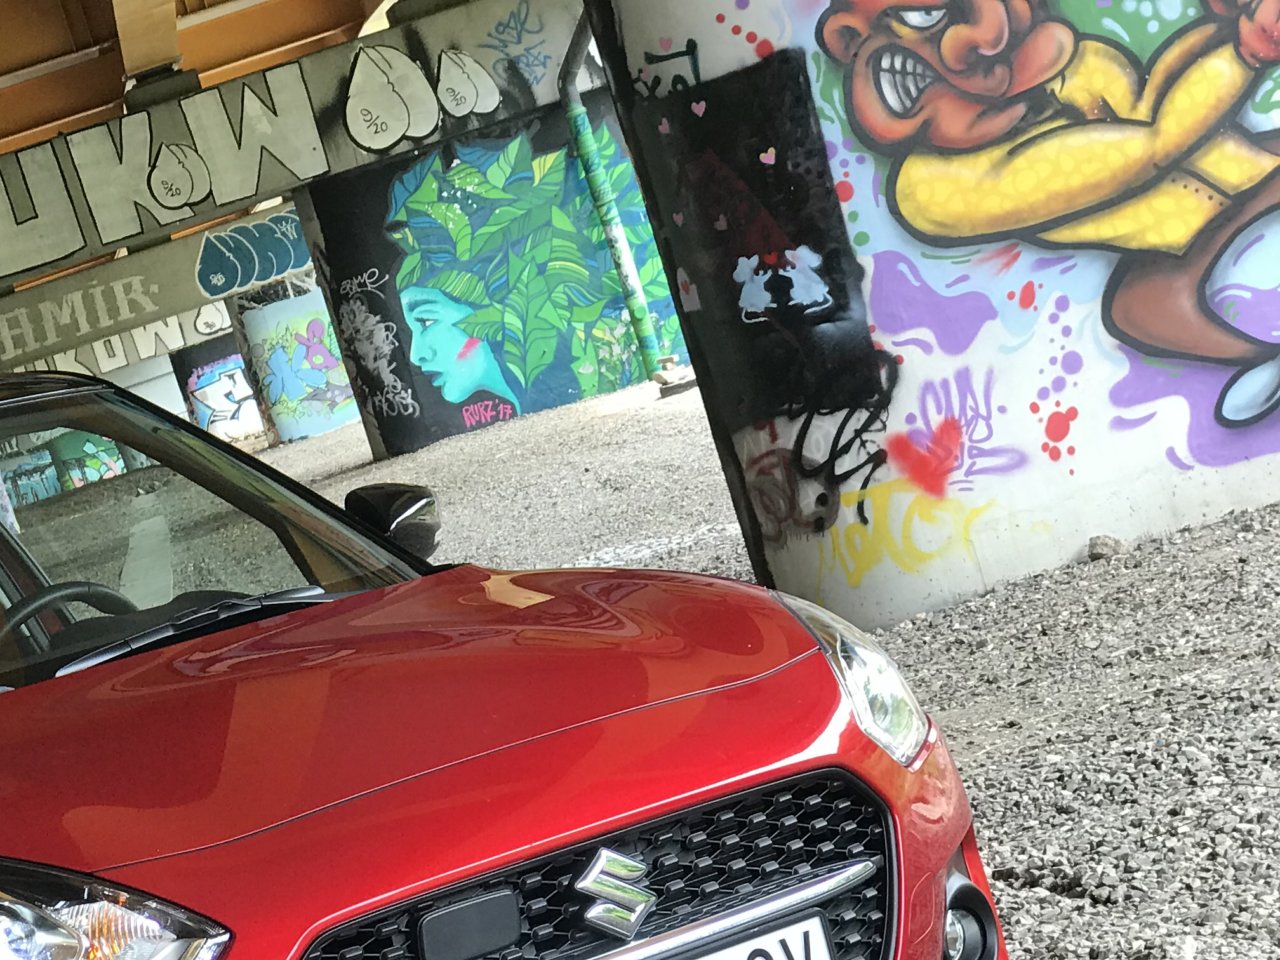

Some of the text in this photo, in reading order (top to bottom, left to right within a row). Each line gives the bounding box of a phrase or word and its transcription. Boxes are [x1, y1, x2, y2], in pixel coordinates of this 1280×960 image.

[446, 87, 467, 107] 9/20
[360, 108, 389, 134] 9/20
[161, 180, 181, 197] 9/20
